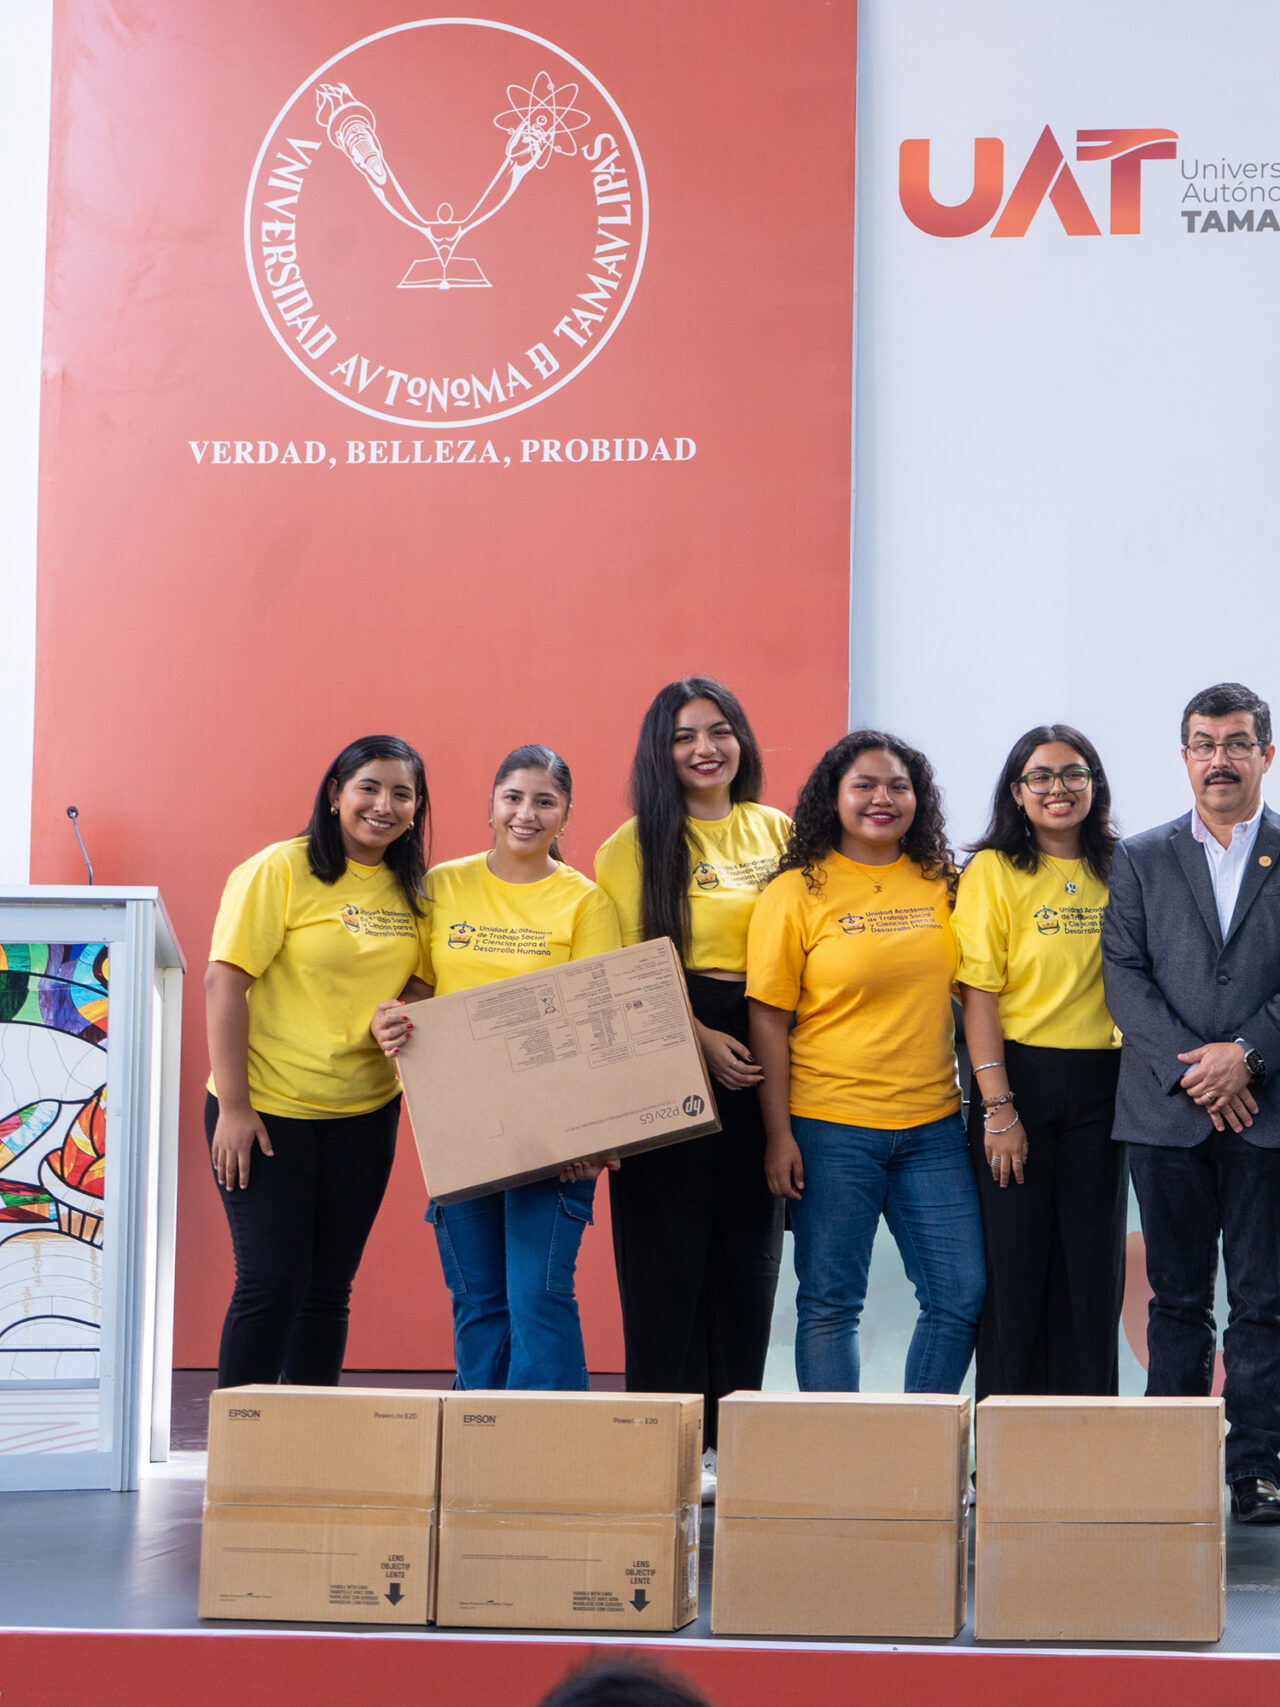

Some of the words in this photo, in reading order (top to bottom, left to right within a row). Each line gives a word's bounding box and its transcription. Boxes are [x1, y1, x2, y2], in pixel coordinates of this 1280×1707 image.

[899, 124, 1179, 238] UAT
[189, 440, 337, 470] VERDAD,
[346, 440, 512, 468] BELLEZA,
[521, 437, 697, 463] PROBIDAD
[865, 909, 893, 917] Unidad
[479, 925, 508, 933] Unidad
[489, 932, 520, 941] Trabajo
[482, 938, 516, 947] Ciencias
[473, 944, 515, 954] Desarrollo
[517, 948, 552, 956] Humano
[229, 1409, 261, 1418] EPSON
[463, 1414, 496, 1424] EPSON
[388, 1554, 405, 1562] LENS
[381, 1562, 411, 1570] OBJECTIF
[632, 1560, 650, 1568] LENS
[385, 1571, 406, 1579] LENTE
[625, 1568, 656, 1576] OBJECTIF
[630, 1577, 651, 1585] LENTE
